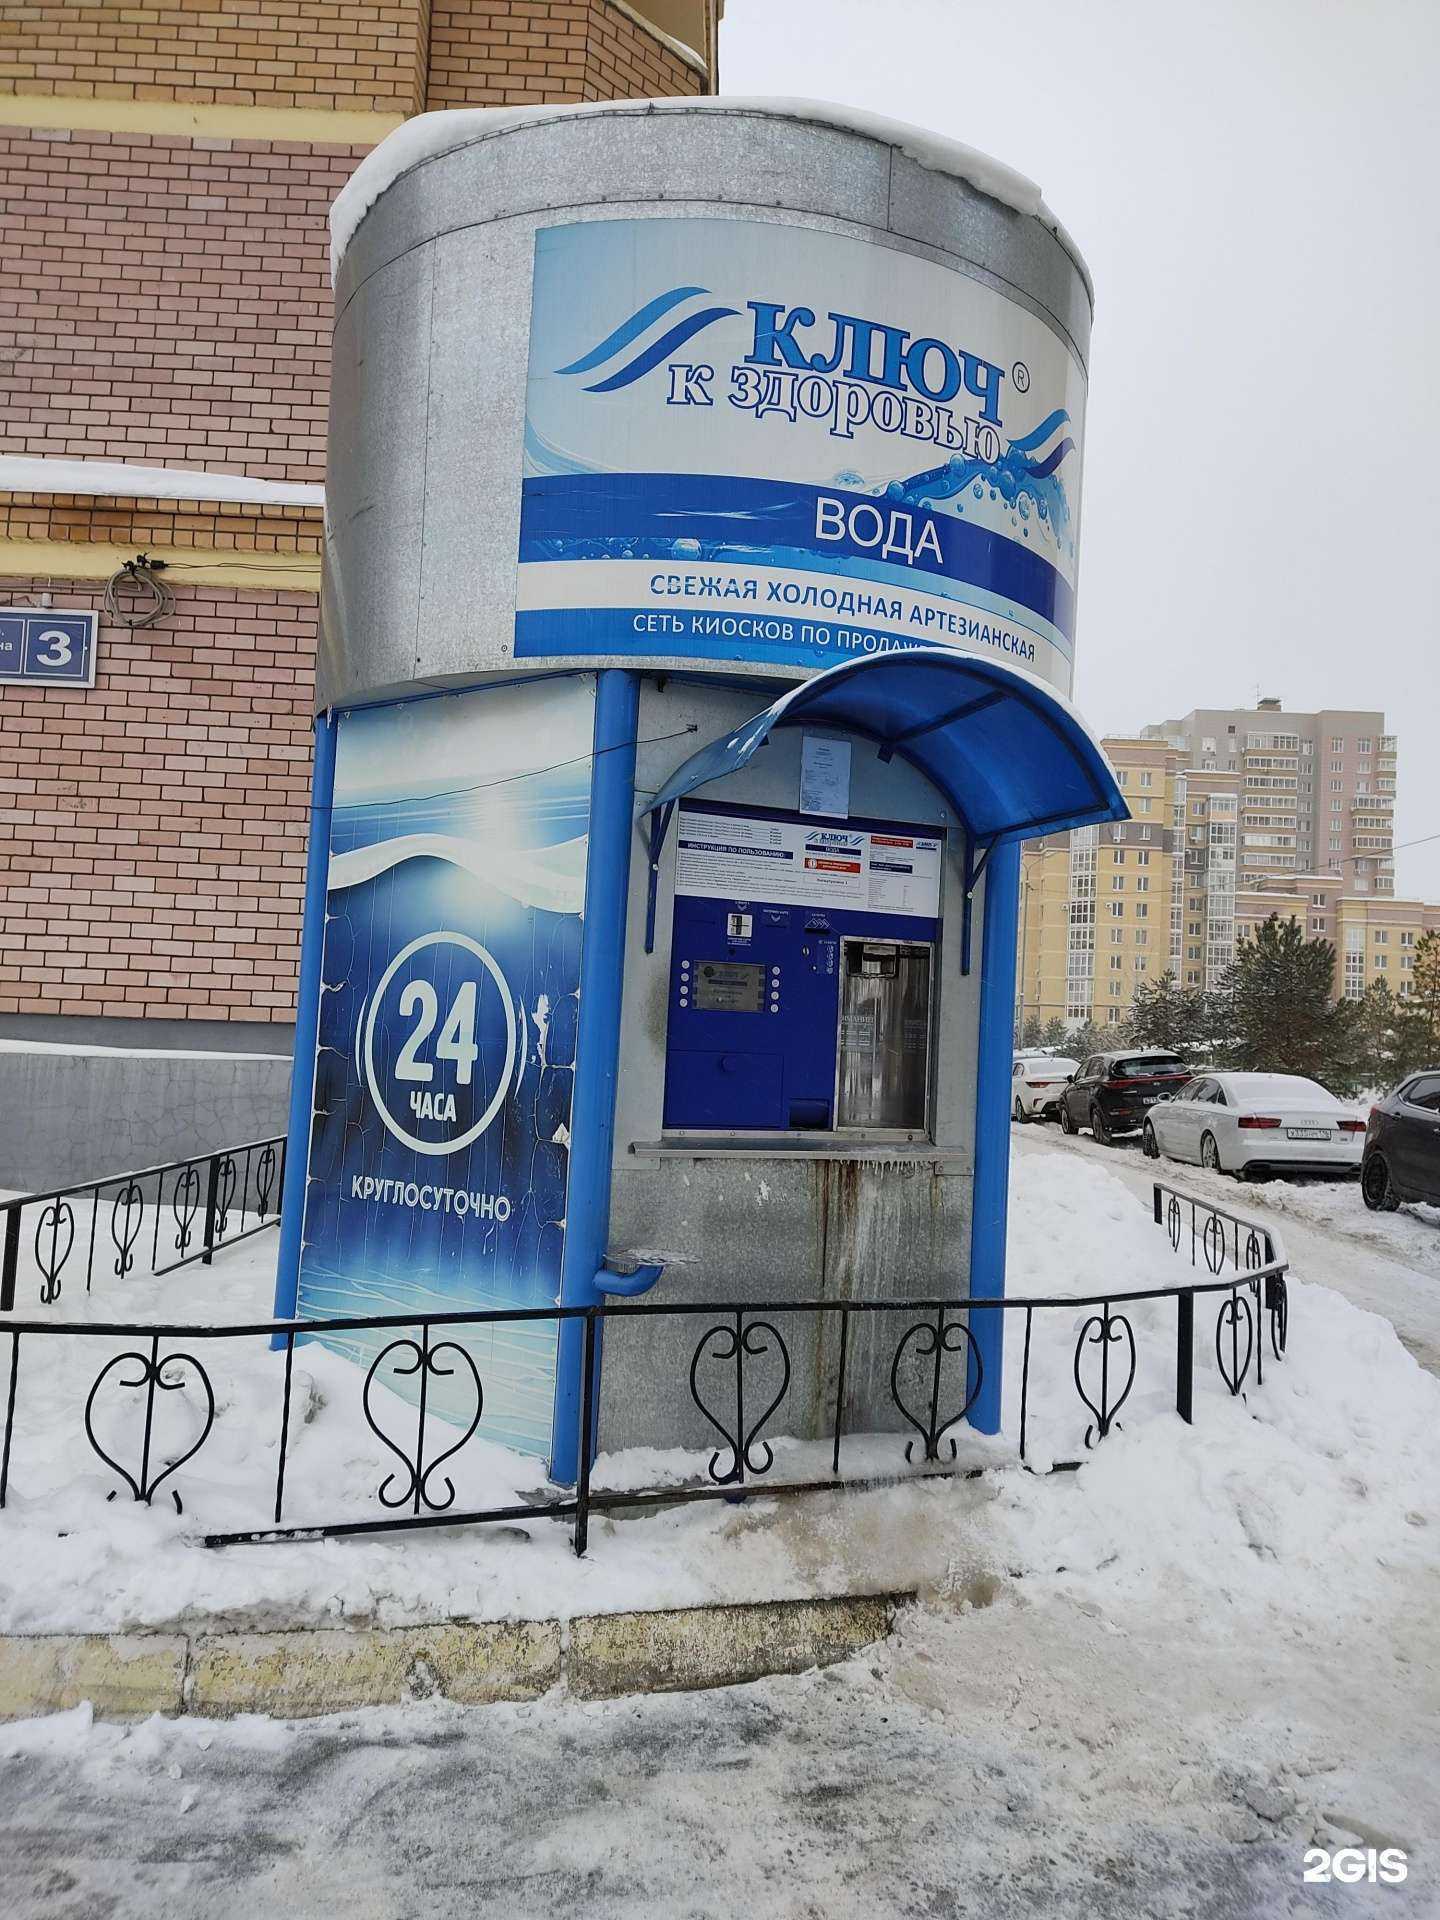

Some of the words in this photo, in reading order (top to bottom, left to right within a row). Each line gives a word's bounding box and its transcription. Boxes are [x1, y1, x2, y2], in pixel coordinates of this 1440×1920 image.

[744, 301, 1005, 427] КЛЮЧ
[815, 496, 944, 565] ВОДА
[632, 614, 685, 633] СЕТЬ
[691, 616, 794, 641] КИОСКОВ
[801, 625, 831, 645] ПО
[650, 574, 758, 600] СВЕЖАЯ
[767, 581, 902, 620] ХОЛОДНАЯ
[909, 605, 1035, 663] АРТЕЗИАНСКАЯ
[36, 630, 73, 667] 3
[394, 979, 479, 1085] 24
[409, 1090, 457, 1122] ЧАСА
[351, 1175, 511, 1222] КРУГЛОСУТОЧНО
